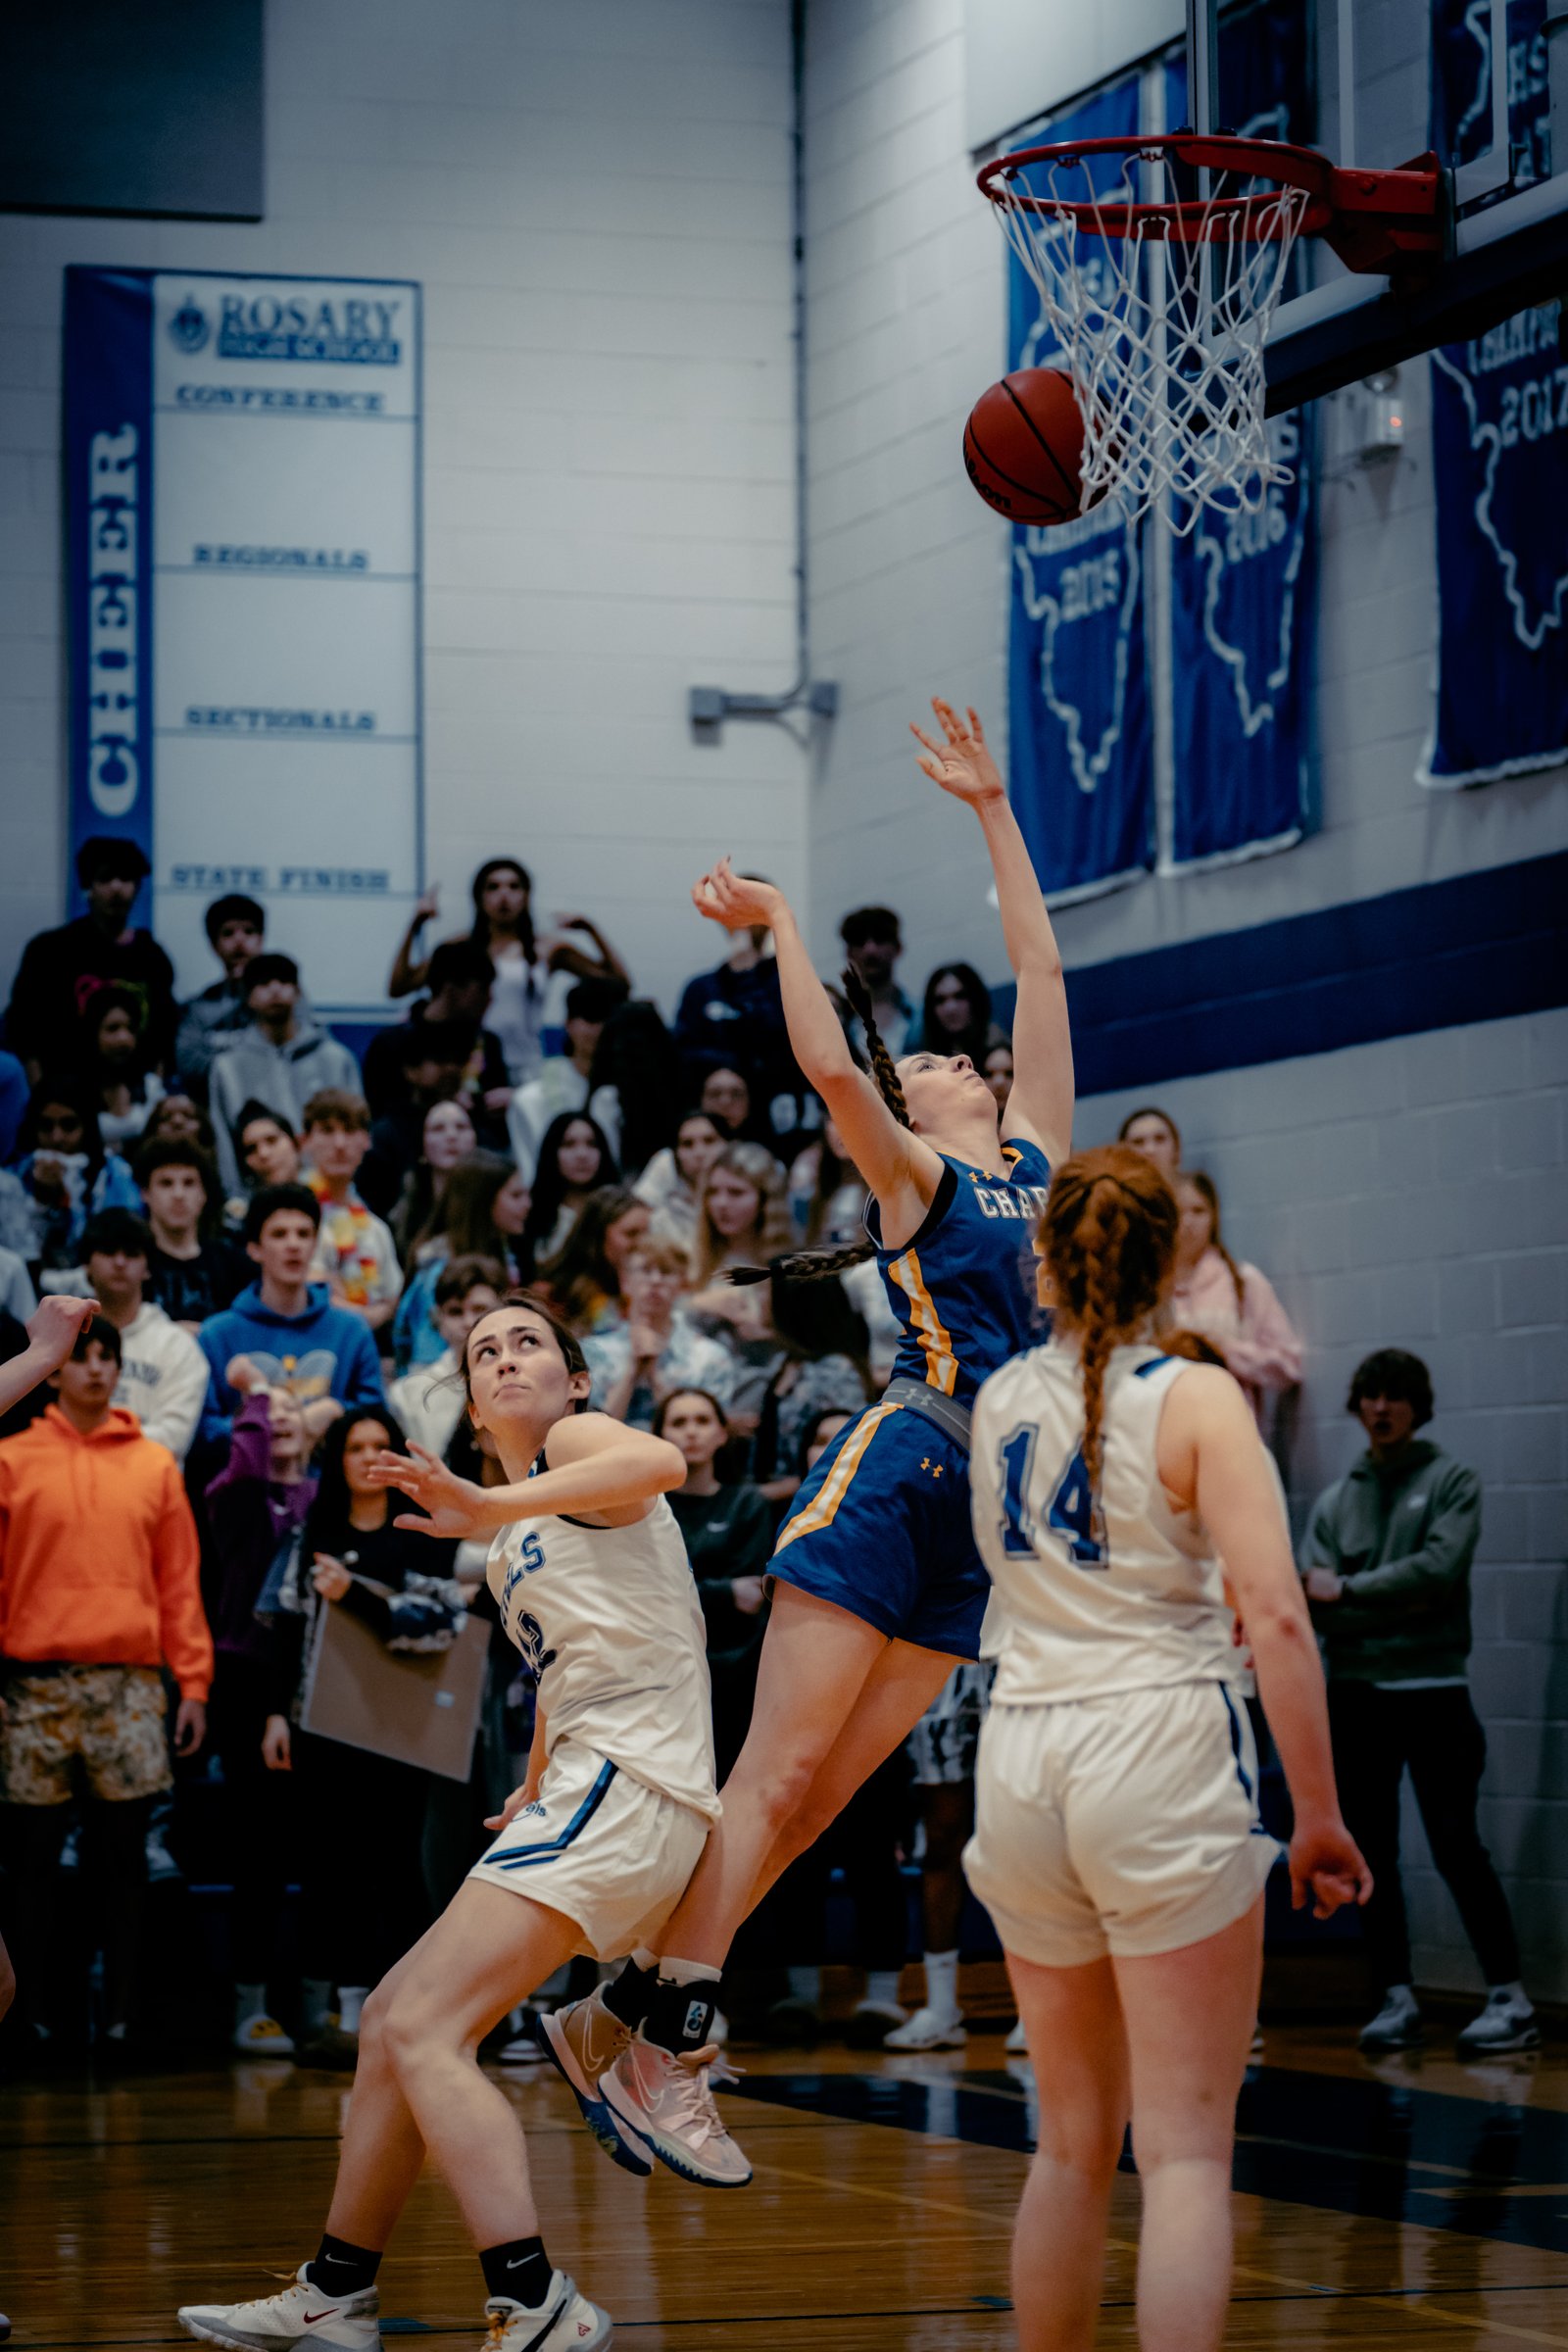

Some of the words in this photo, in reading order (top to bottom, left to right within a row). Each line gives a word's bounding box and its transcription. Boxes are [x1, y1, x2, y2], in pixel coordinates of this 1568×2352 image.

[219, 294, 401, 339] ROSARY
[176, 385, 386, 411] CONFERENCE
[1499, 366, 1568, 449] 2017
[194, 544, 369, 570] REGIONALS
[89, 422, 139, 817] CHEER
[185, 706, 375, 733] SECTIONALS
[171, 864, 267, 889] STATE
[279, 865, 389, 893] FINISH
[997, 1422, 1109, 1570] 14
